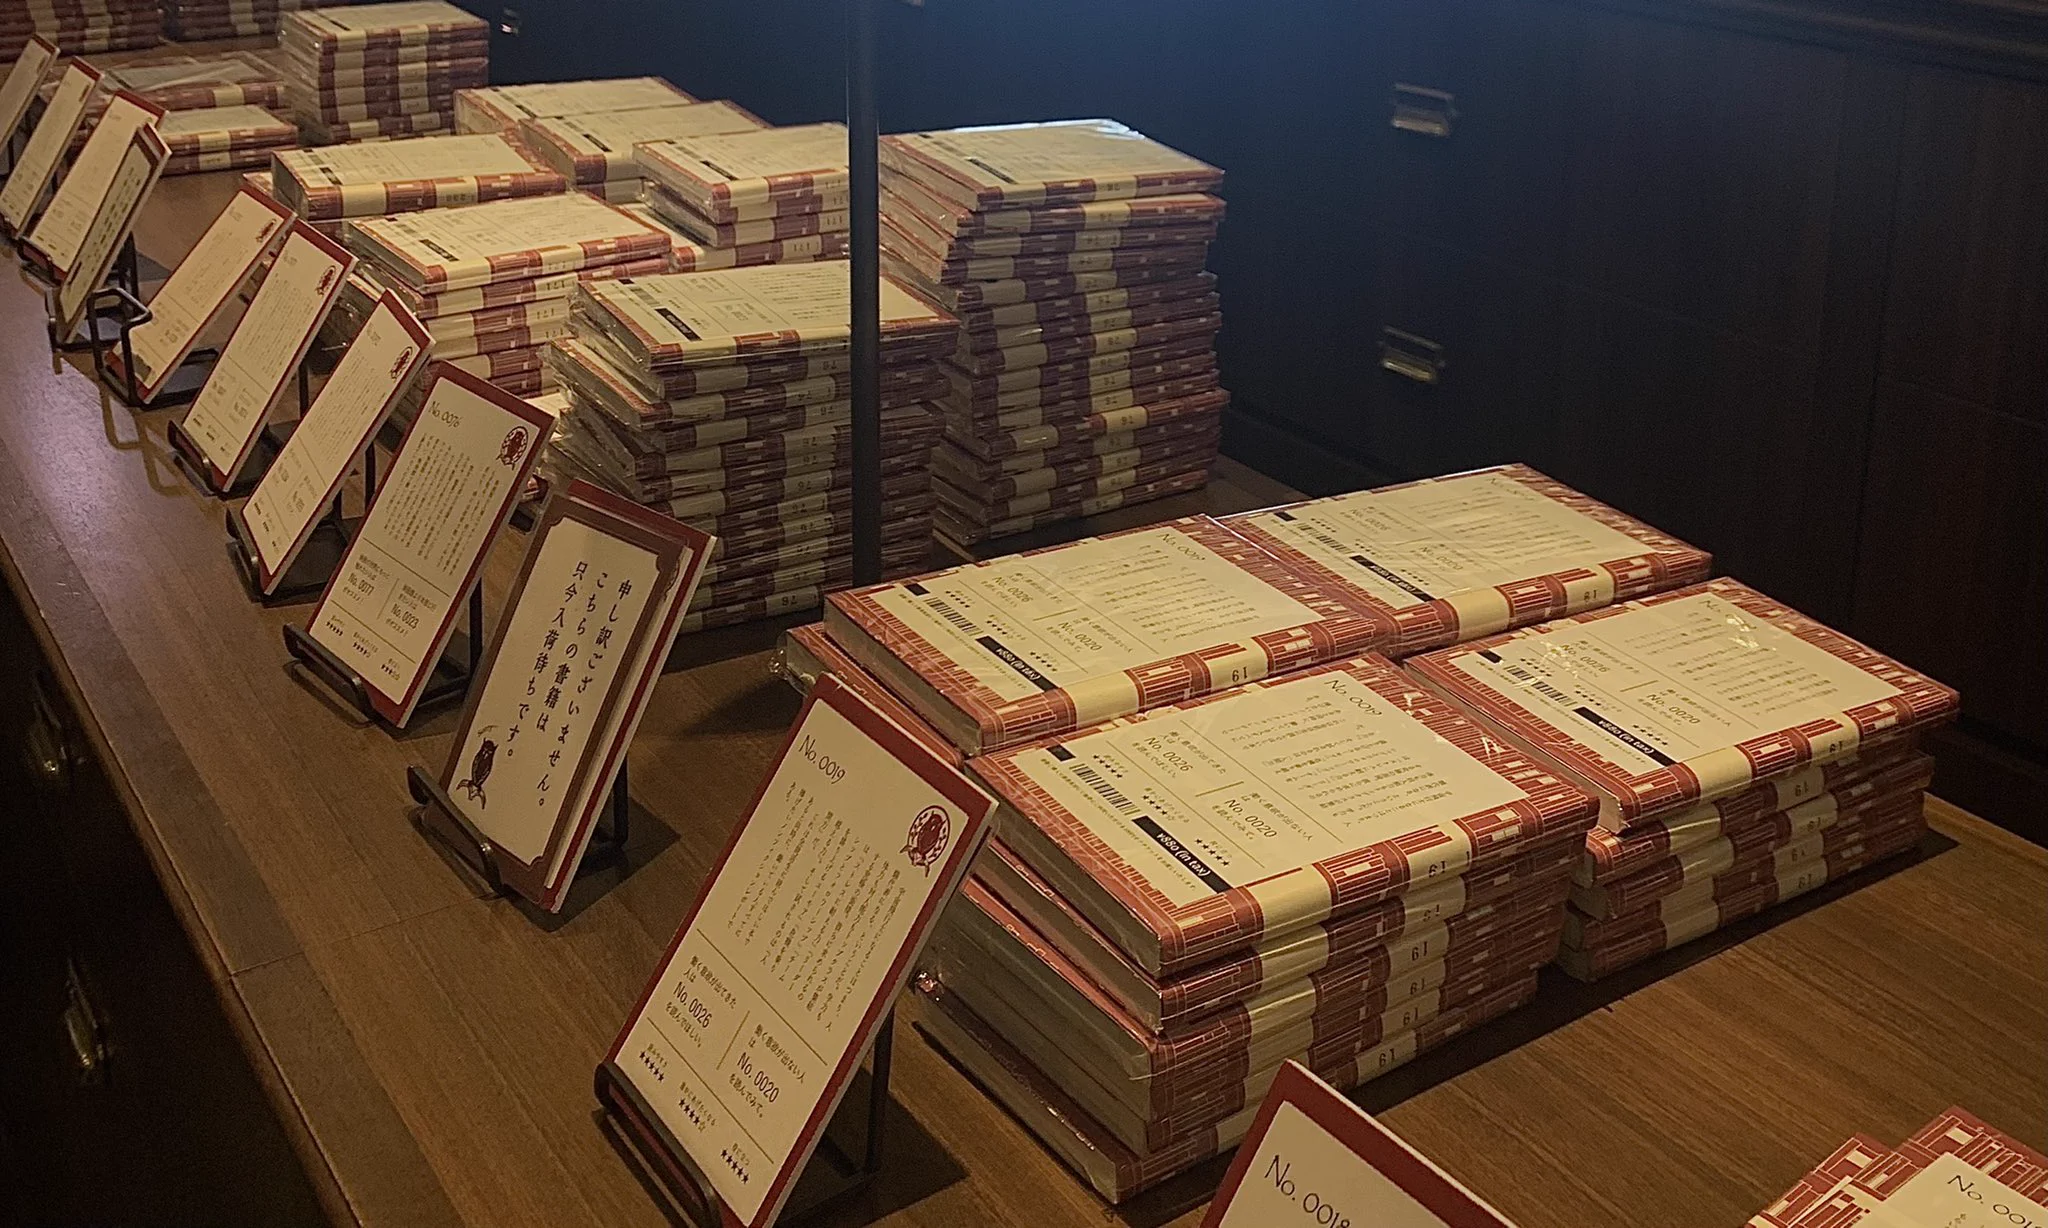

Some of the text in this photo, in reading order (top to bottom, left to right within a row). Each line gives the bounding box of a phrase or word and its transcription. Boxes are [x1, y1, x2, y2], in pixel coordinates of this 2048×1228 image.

[991, 576, 1007, 585] No.
[1057, 621, 1102, 650] No. 0020
[507, 561, 588, 757] 只今入荷待ちです。
[535, 571, 609, 734] こちらの書籍は
[1231, 665, 1248, 682] 19
[535, 579, 633, 807] 申し訳ございません。
[1323, 679, 1382, 715] No. 0019
[1646, 694, 1700, 723] No. 0020
[798, 734, 845, 784] No. 0019
[1144, 737, 1193, 771] No. 0026
[1224, 799, 1277, 837] No. 0020
[1174, 849, 1191, 861] (in
[1190, 858, 1211, 876] tax)
[1429, 860, 1446, 878] 19
[1412, 941, 1428, 960] 19
[683, 967, 696, 982] 人は
[1410, 978, 1425, 996] 19
[673, 981, 712, 1028] No. 0026
[1404, 1007, 1418, 1026] 19
[665, 1001, 701, 1047] を読んでほしい。
[748, 1037, 755, 1048] は
[754, 1023, 805, 1083] 働く意欲が出ない人
[1379, 1048, 1396, 1068] 19
[736, 1051, 779, 1102] No. 0020
[729, 1073, 763, 1117] を読んでみて。
[1264, 1154, 1296, 1201] No.
[1947, 1174, 1984, 1205] No.
